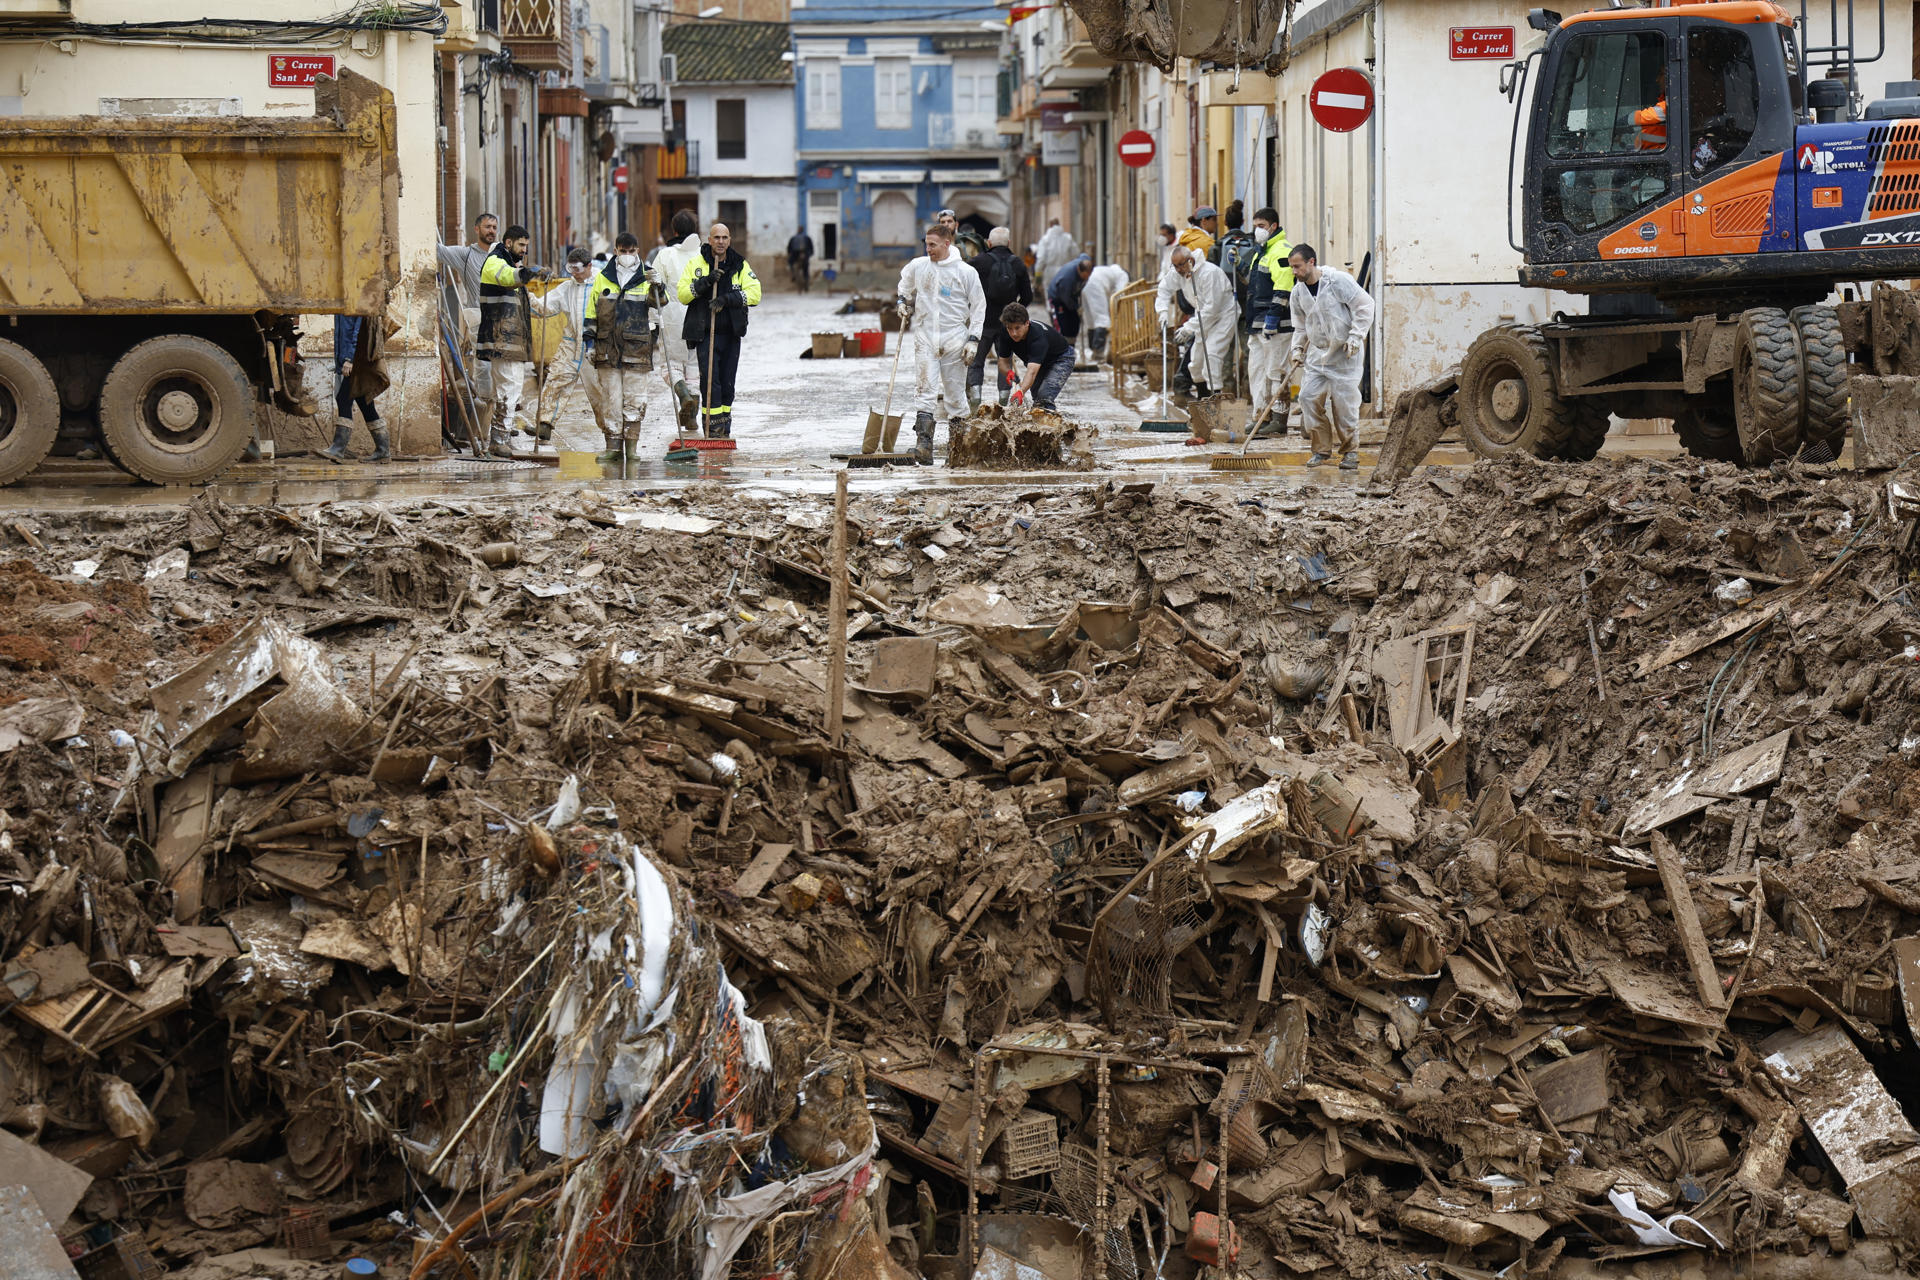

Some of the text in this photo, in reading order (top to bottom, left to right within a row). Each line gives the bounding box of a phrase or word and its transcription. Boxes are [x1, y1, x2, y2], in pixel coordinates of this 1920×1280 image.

[1472, 32, 1503, 40] Carrer
[1457, 45, 1508, 54] Sant Jordi
[292, 60, 323, 69] Carrer
[275, 73, 297, 81] Sant
[1613, 246, 1657, 254] DOOSAN
